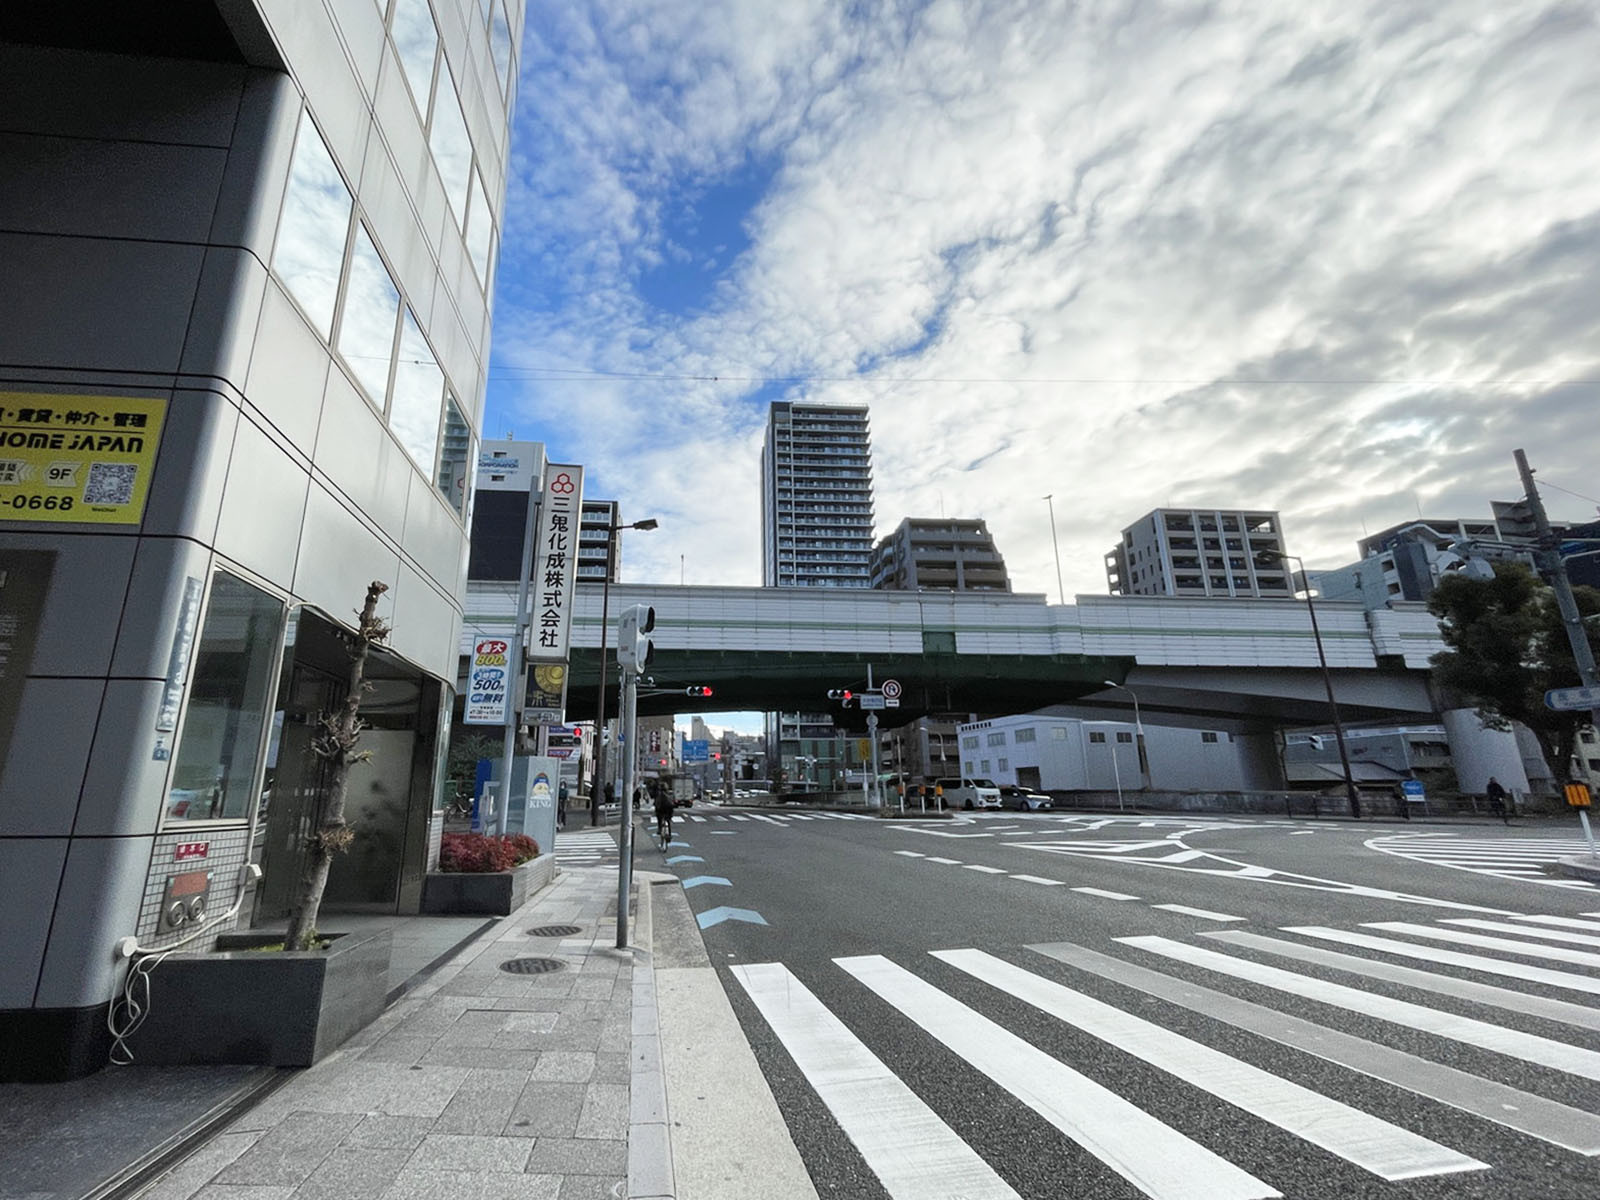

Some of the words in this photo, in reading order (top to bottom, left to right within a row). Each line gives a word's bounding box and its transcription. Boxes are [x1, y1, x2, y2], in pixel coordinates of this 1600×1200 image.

[0, 407, 147, 427] ・賃貸・仲介・管理
[49, 468, 72, 480] 9F
[0, 494, 74, 511] -0668
[538, 497, 571, 648] 三鬼化成株式会社
[529, 800, 552, 808] KING
